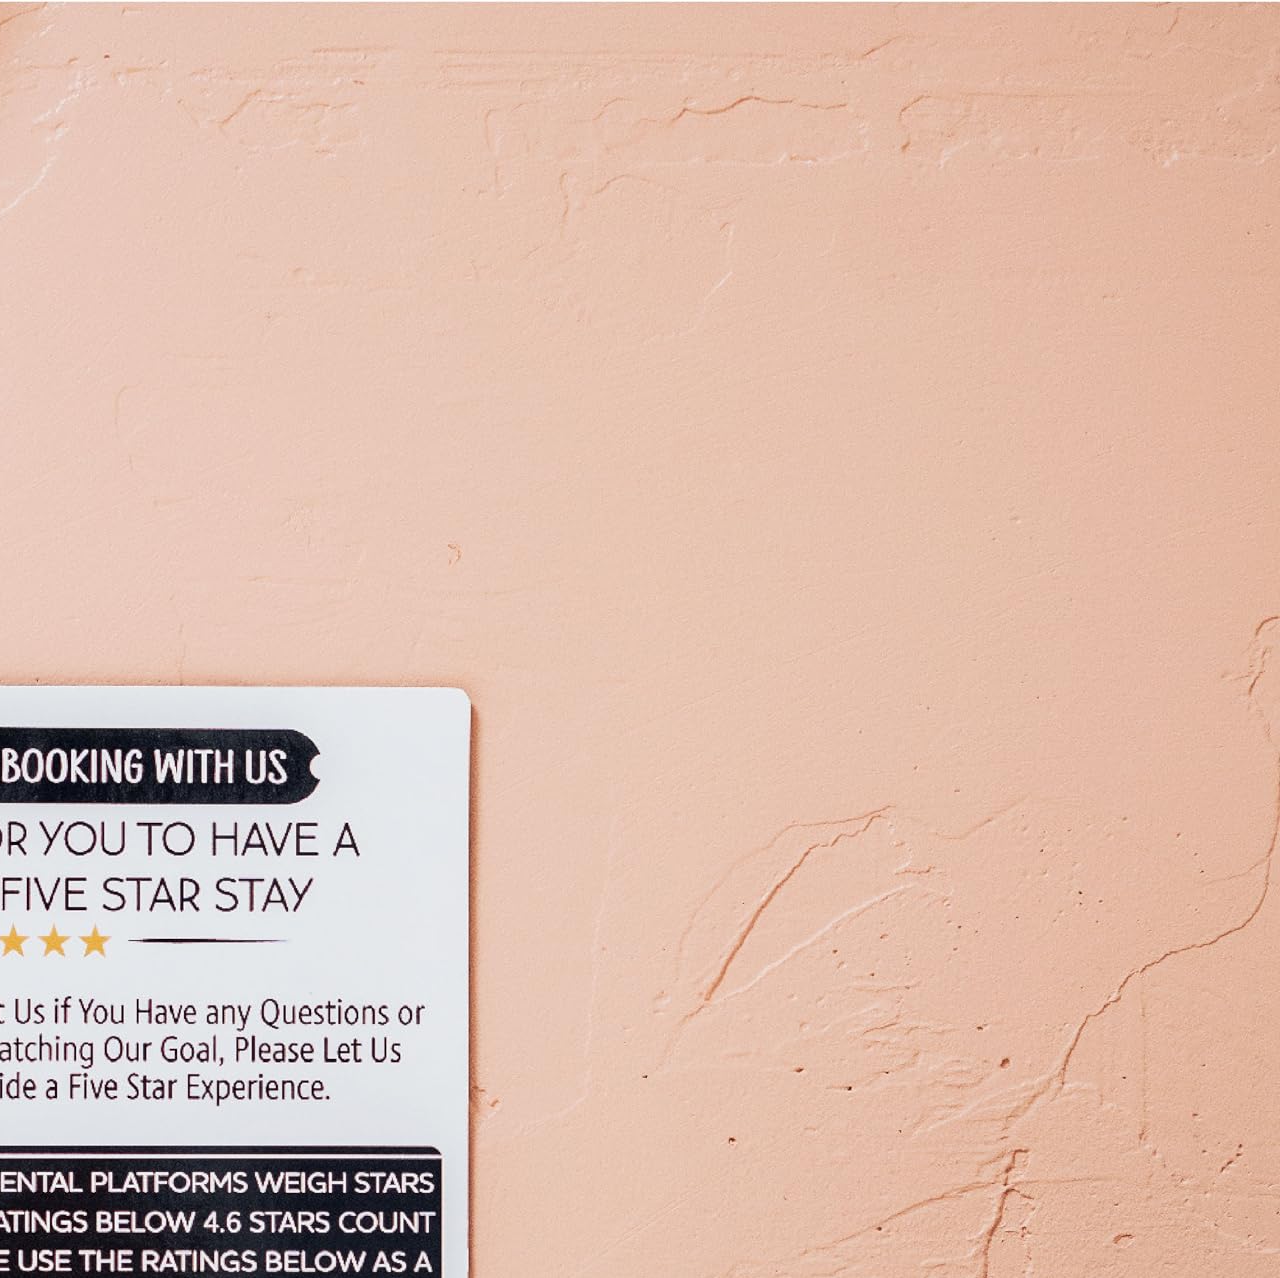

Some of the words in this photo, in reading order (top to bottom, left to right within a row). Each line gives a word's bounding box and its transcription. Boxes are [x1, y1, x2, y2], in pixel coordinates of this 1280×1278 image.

[1, 747, 144, 784] BOOKING
[153, 748, 235, 784] WITH
[245, 748, 288, 785] US
[38, 820, 126, 857] YOU
[135, 821, 196, 857] TO
[211, 821, 320, 857] HAVE
[332, 822, 361, 857] A
[1, 876, 88, 912] FIVE
[102, 876, 201, 913] STAR
[215, 877, 314, 913] STAY
[14, 998, 46, 1025] Us
[54, 995, 72, 1025] if
[78, 998, 125, 1025] You
[135, 998, 197, 1025] Have
[206, 1004, 252, 1031] any
[260, 998, 390, 1030] Questions
[397, 1004, 426, 1026] or
[103, 1035, 153, 1063] Our
[160, 1034, 224, 1067] Goal,
[235, 1034, 315, 1064] Please
[323, 1036, 363, 1064] Let
[371, 1036, 402, 1064] Us
[45, 1078, 58, 1101] a
[69, 1072, 118, 1101] Five
[126, 1072, 178, 1101] Star
[187, 1073, 330, 1107] Experience.
[90, 1171, 249, 1194] PLATFORMS
[254, 1171, 347, 1194] WEIGH
[354, 1171, 435, 1194] STARS
[95, 1210, 196, 1234] BELOW
[203, 1210, 242, 1234] 4.6
[249, 1210, 331, 1234] STARS
[338, 1211, 437, 1234] COUNT
[17, 1249, 73, 1272] USE
[78, 1249, 134, 1273] THE
[141, 1249, 258, 1273] RATINGS
[265, 1249, 367, 1273] BELOW
[372, 1250, 407, 1273] AS
[413, 1250, 433, 1273] A
